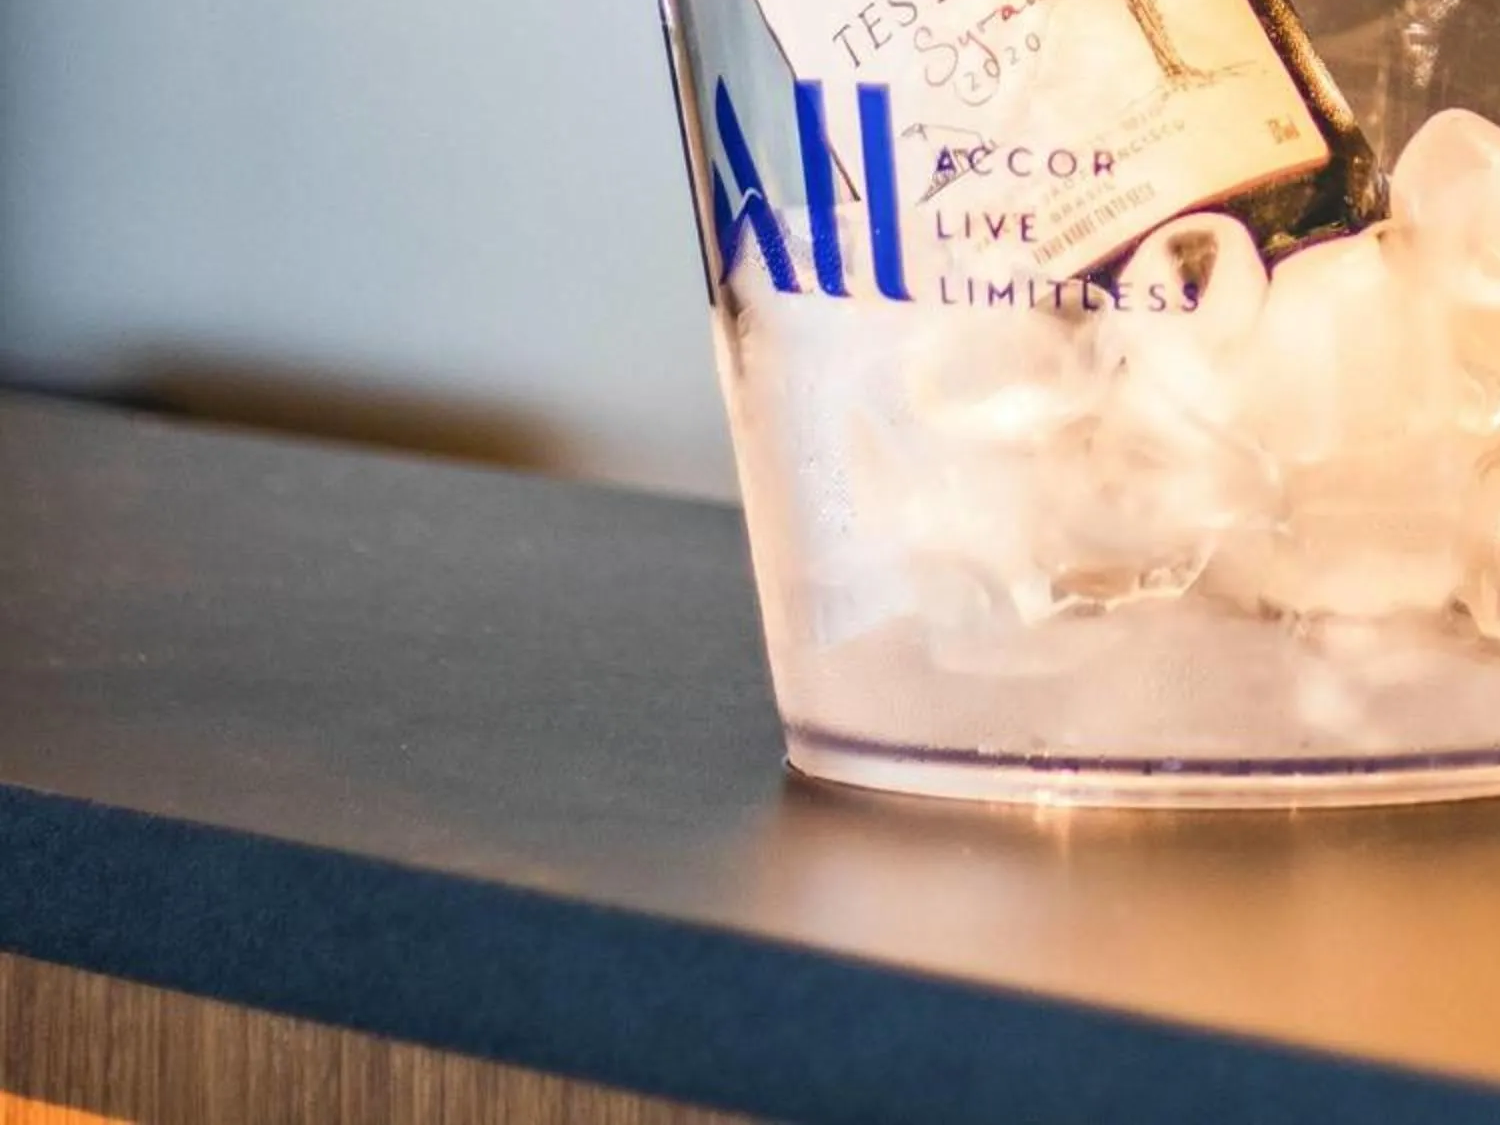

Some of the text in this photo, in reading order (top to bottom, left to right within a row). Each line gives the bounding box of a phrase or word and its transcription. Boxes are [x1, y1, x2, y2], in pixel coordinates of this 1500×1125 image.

[934, 145, 1117, 178] ACCOR
[935, 210, 1040, 243] LIVE
[939, 275, 1201, 314] LIMITLESS
